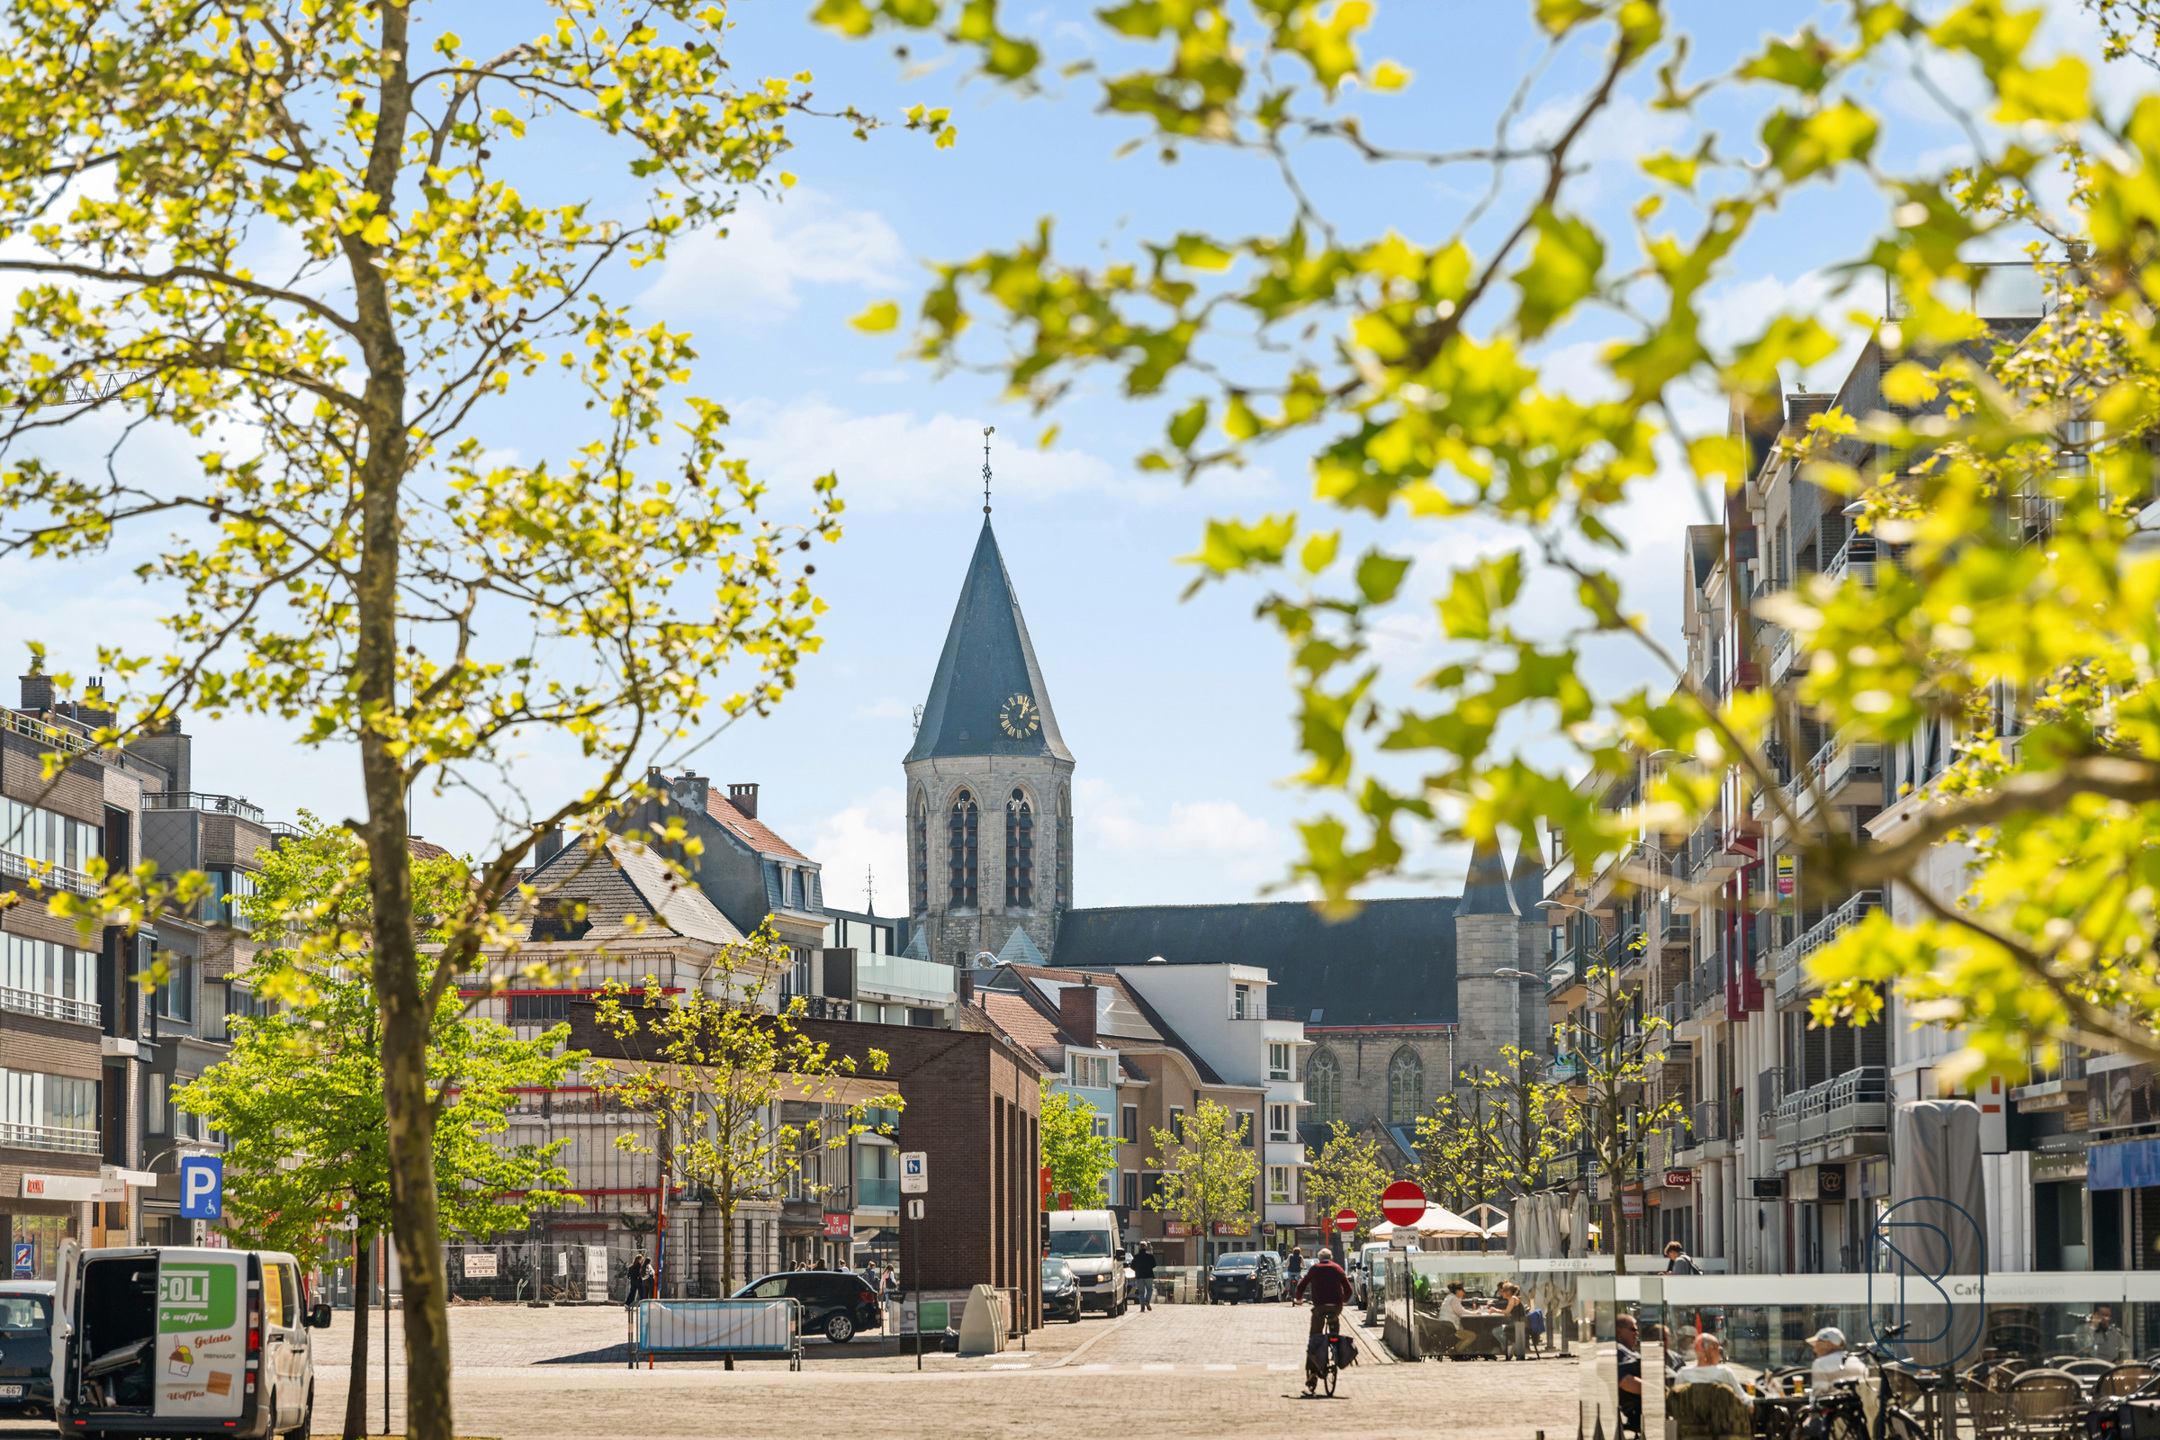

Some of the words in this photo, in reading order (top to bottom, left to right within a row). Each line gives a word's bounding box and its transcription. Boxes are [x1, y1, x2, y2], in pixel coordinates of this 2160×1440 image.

[187, 1167, 216, 1208] P
[173, 1312, 208, 1324] waffles
[194, 1334, 232, 1349] Gelato
[167, 1390, 205, 1401] Waffles
